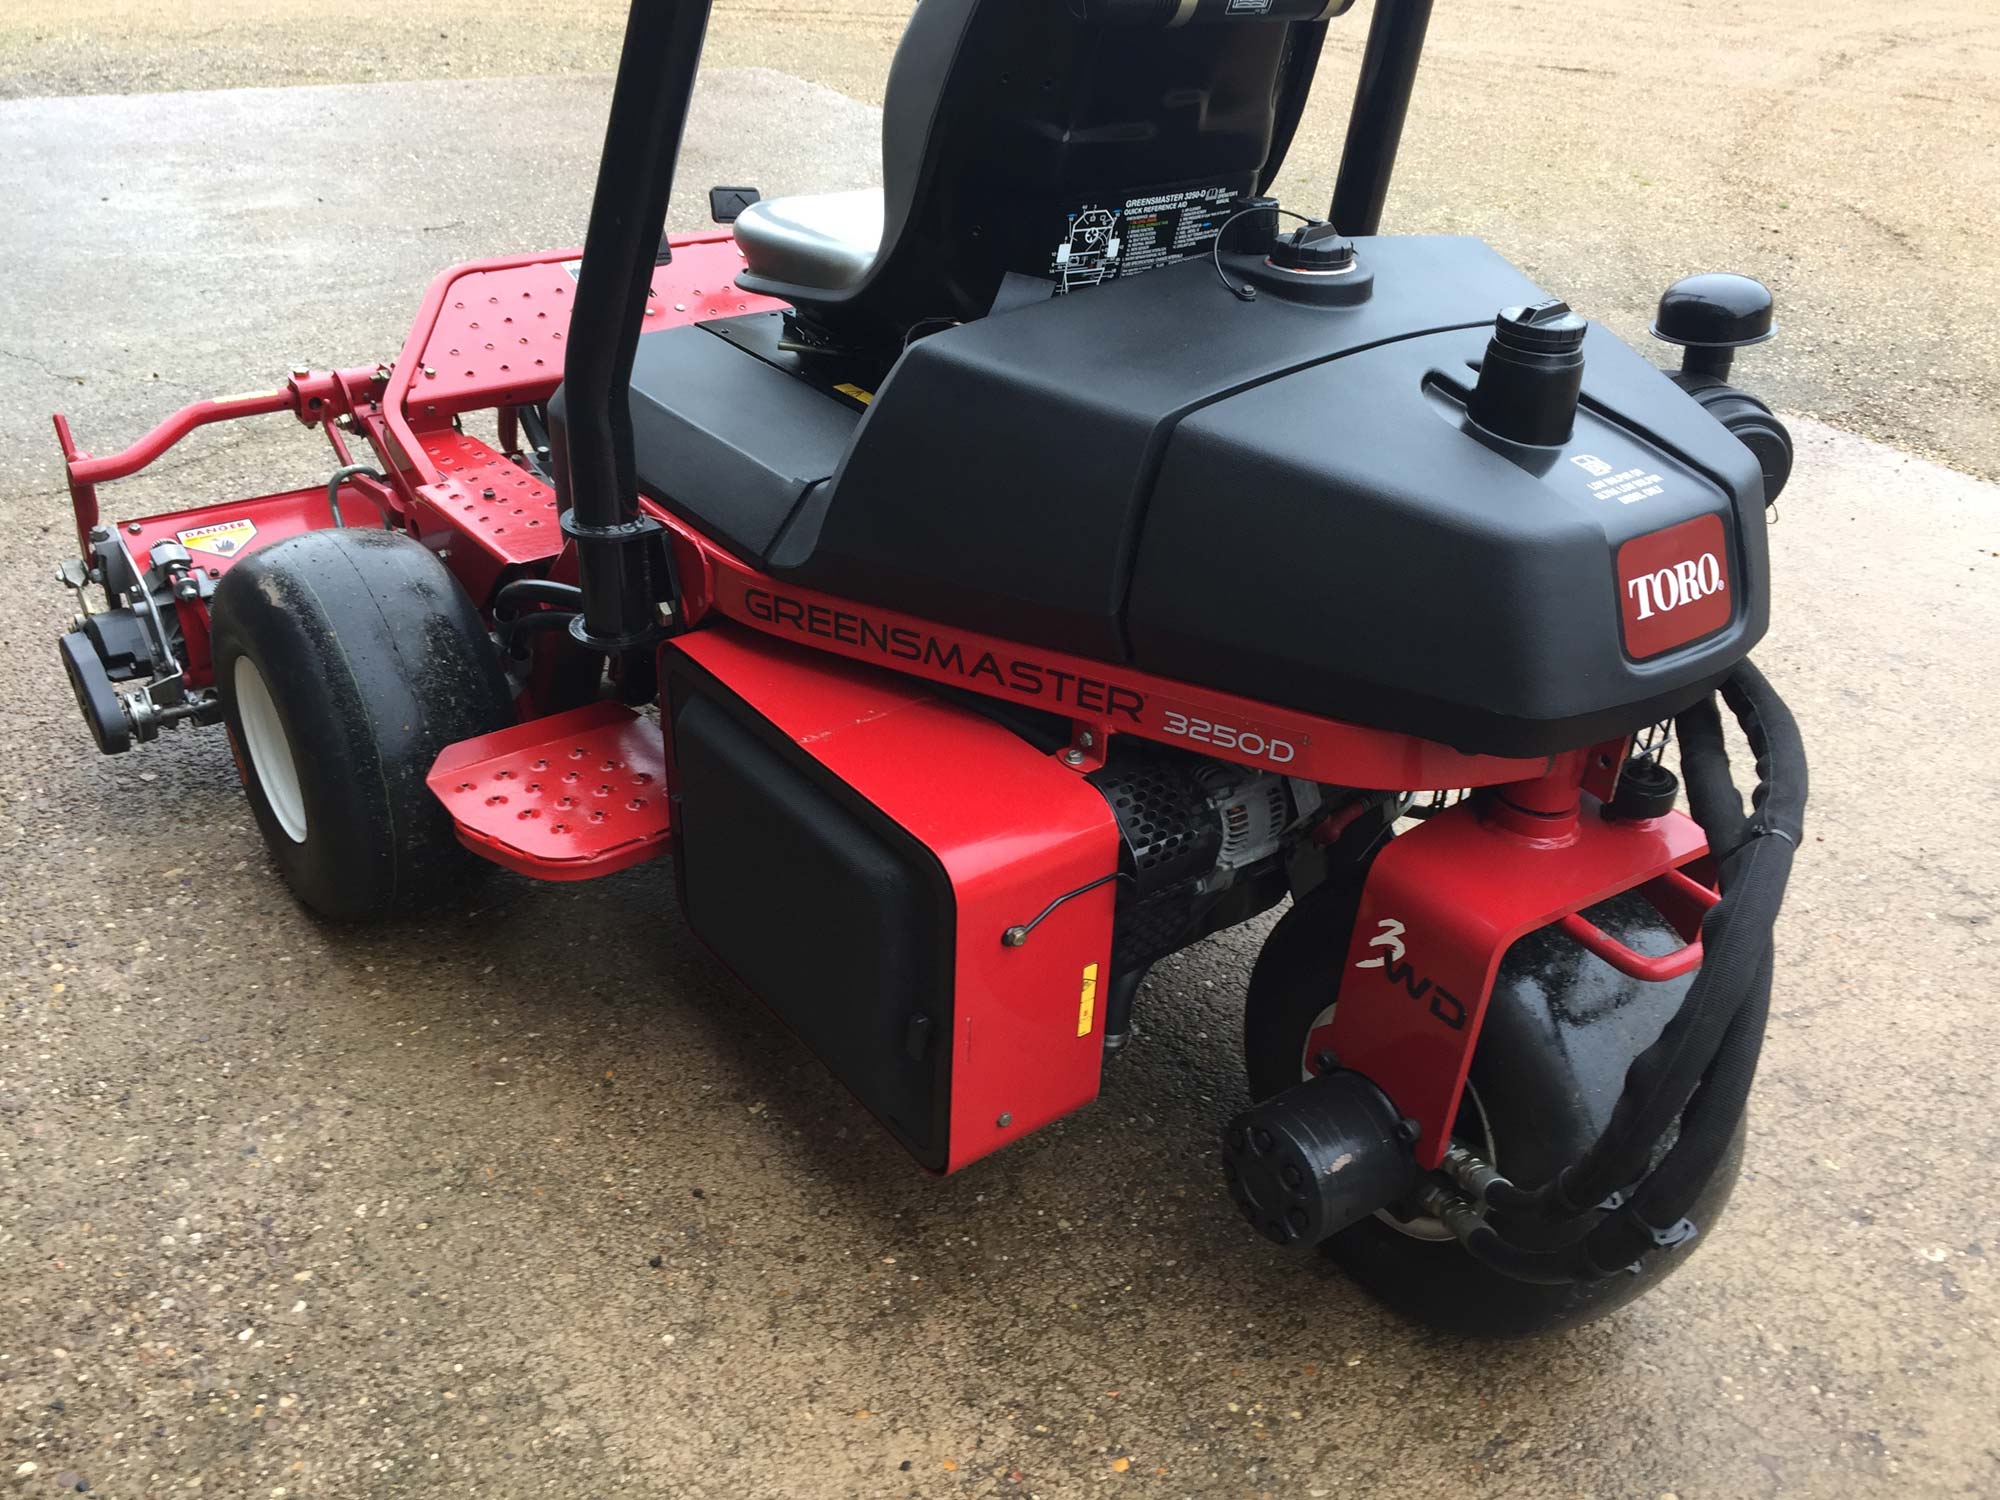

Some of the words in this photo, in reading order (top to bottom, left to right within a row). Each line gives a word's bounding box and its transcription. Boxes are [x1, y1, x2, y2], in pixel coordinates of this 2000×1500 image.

[1124, 206, 1143, 216] QUICK
[1143, 202, 1177, 213] REFERENCE
[1177, 201, 1188, 209] AID
[1125, 193, 1184, 208] GREENSMASTER
[185, 521, 246, 538] DANGER
[743, 587, 1145, 723] GREENSMASTER
